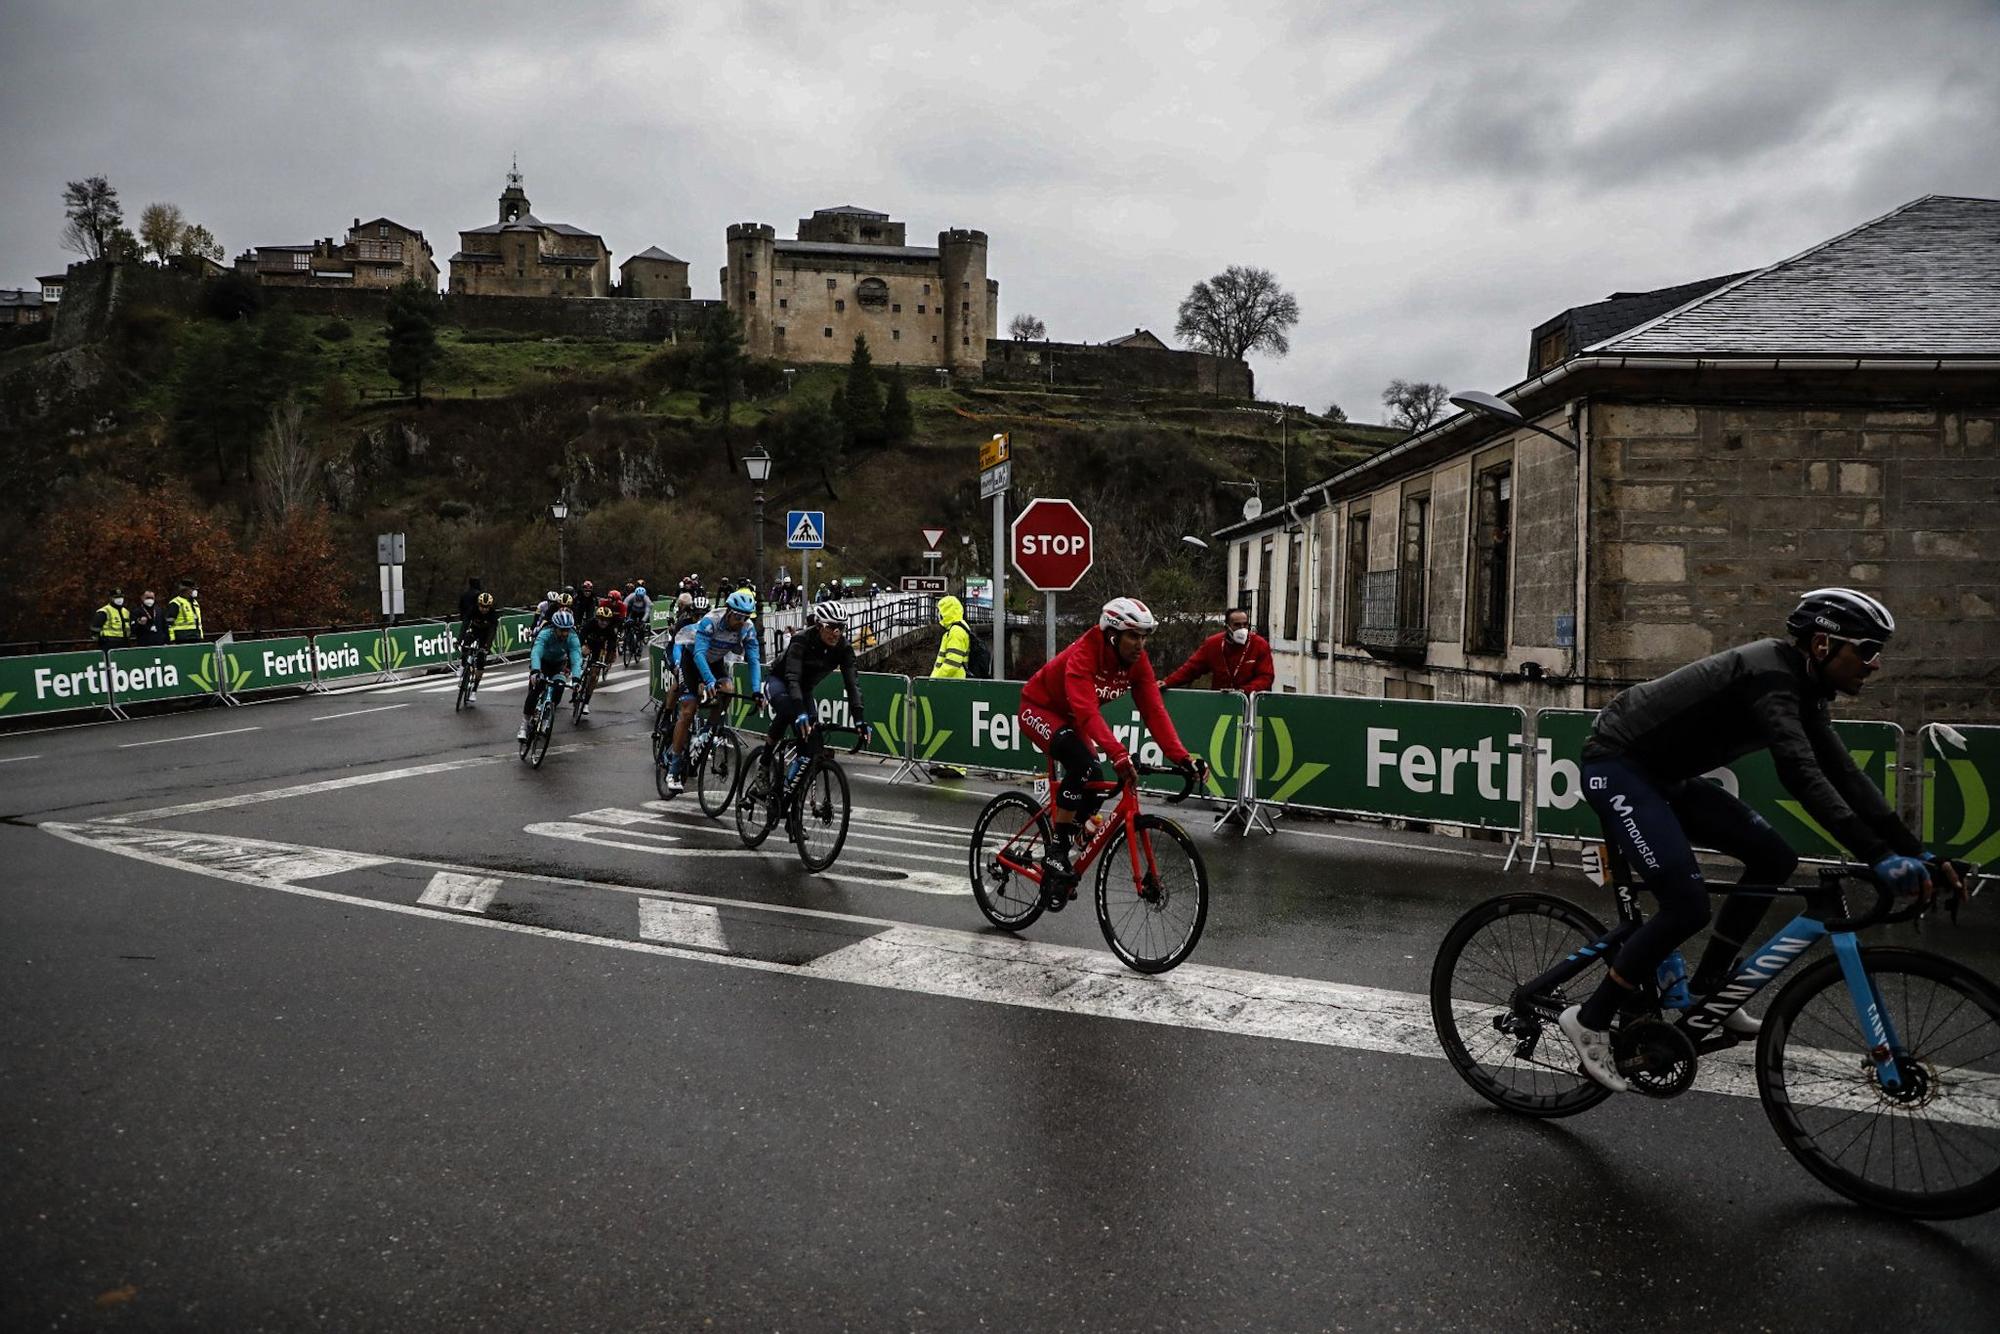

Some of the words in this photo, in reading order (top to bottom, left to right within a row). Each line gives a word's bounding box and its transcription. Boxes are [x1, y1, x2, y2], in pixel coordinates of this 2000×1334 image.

[1021, 534, 1085, 556] STOP
[921, 580, 941, 590] Tera
[262, 642, 360, 677] Fertiberia
[34, 657, 179, 700] Fertiberia
[1020, 708, 1052, 740] Cofidis
[1623, 816, 1661, 871] movistar
[1581, 850, 1600, 875] 171
[1687, 935, 1812, 1031] CANYON
